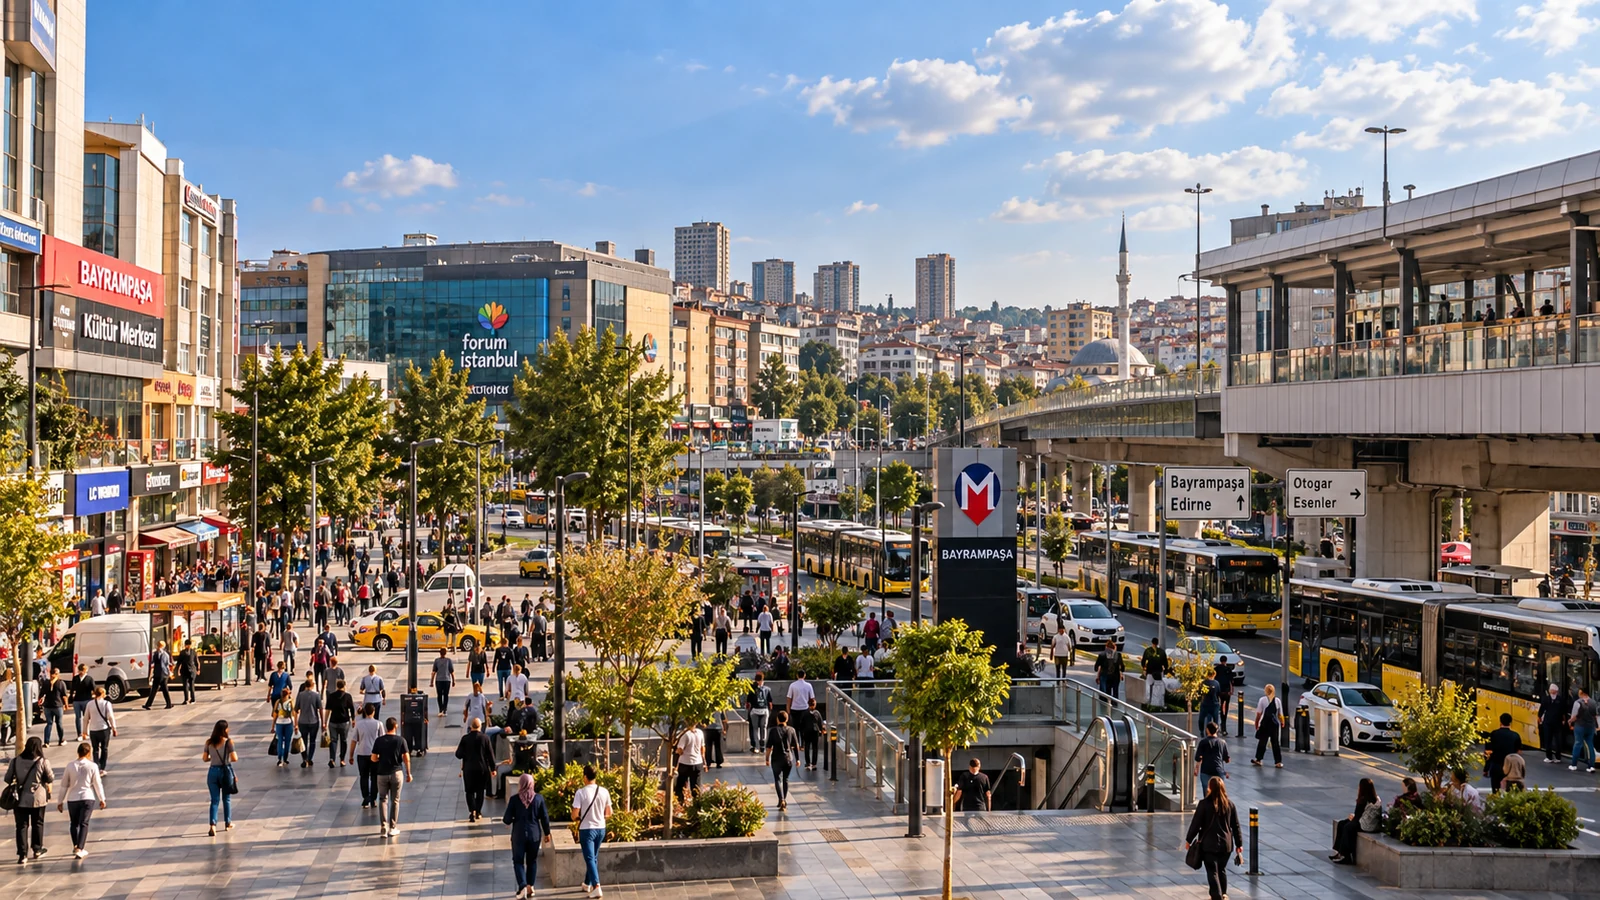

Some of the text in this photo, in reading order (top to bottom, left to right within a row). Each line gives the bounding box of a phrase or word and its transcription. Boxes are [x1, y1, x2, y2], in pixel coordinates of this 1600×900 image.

[80, 259, 153, 305] BAYRAMPAŞA
[84, 312, 119, 342] Kültür
[120, 320, 157, 350] Merkezi
[461, 332, 507, 350] forum
[460, 349, 518, 368] istanbul
[961, 471, 996, 511] M
[1170, 474, 1245, 492] Bayrampaşa
[1293, 476, 1333, 492] Otogar
[88, 486, 98, 501] LC
[1293, 496, 1337, 509] Esenler
[1170, 496, 1212, 512] Edirne
[941, 548, 1014, 562] BAYRAMPAŞA
